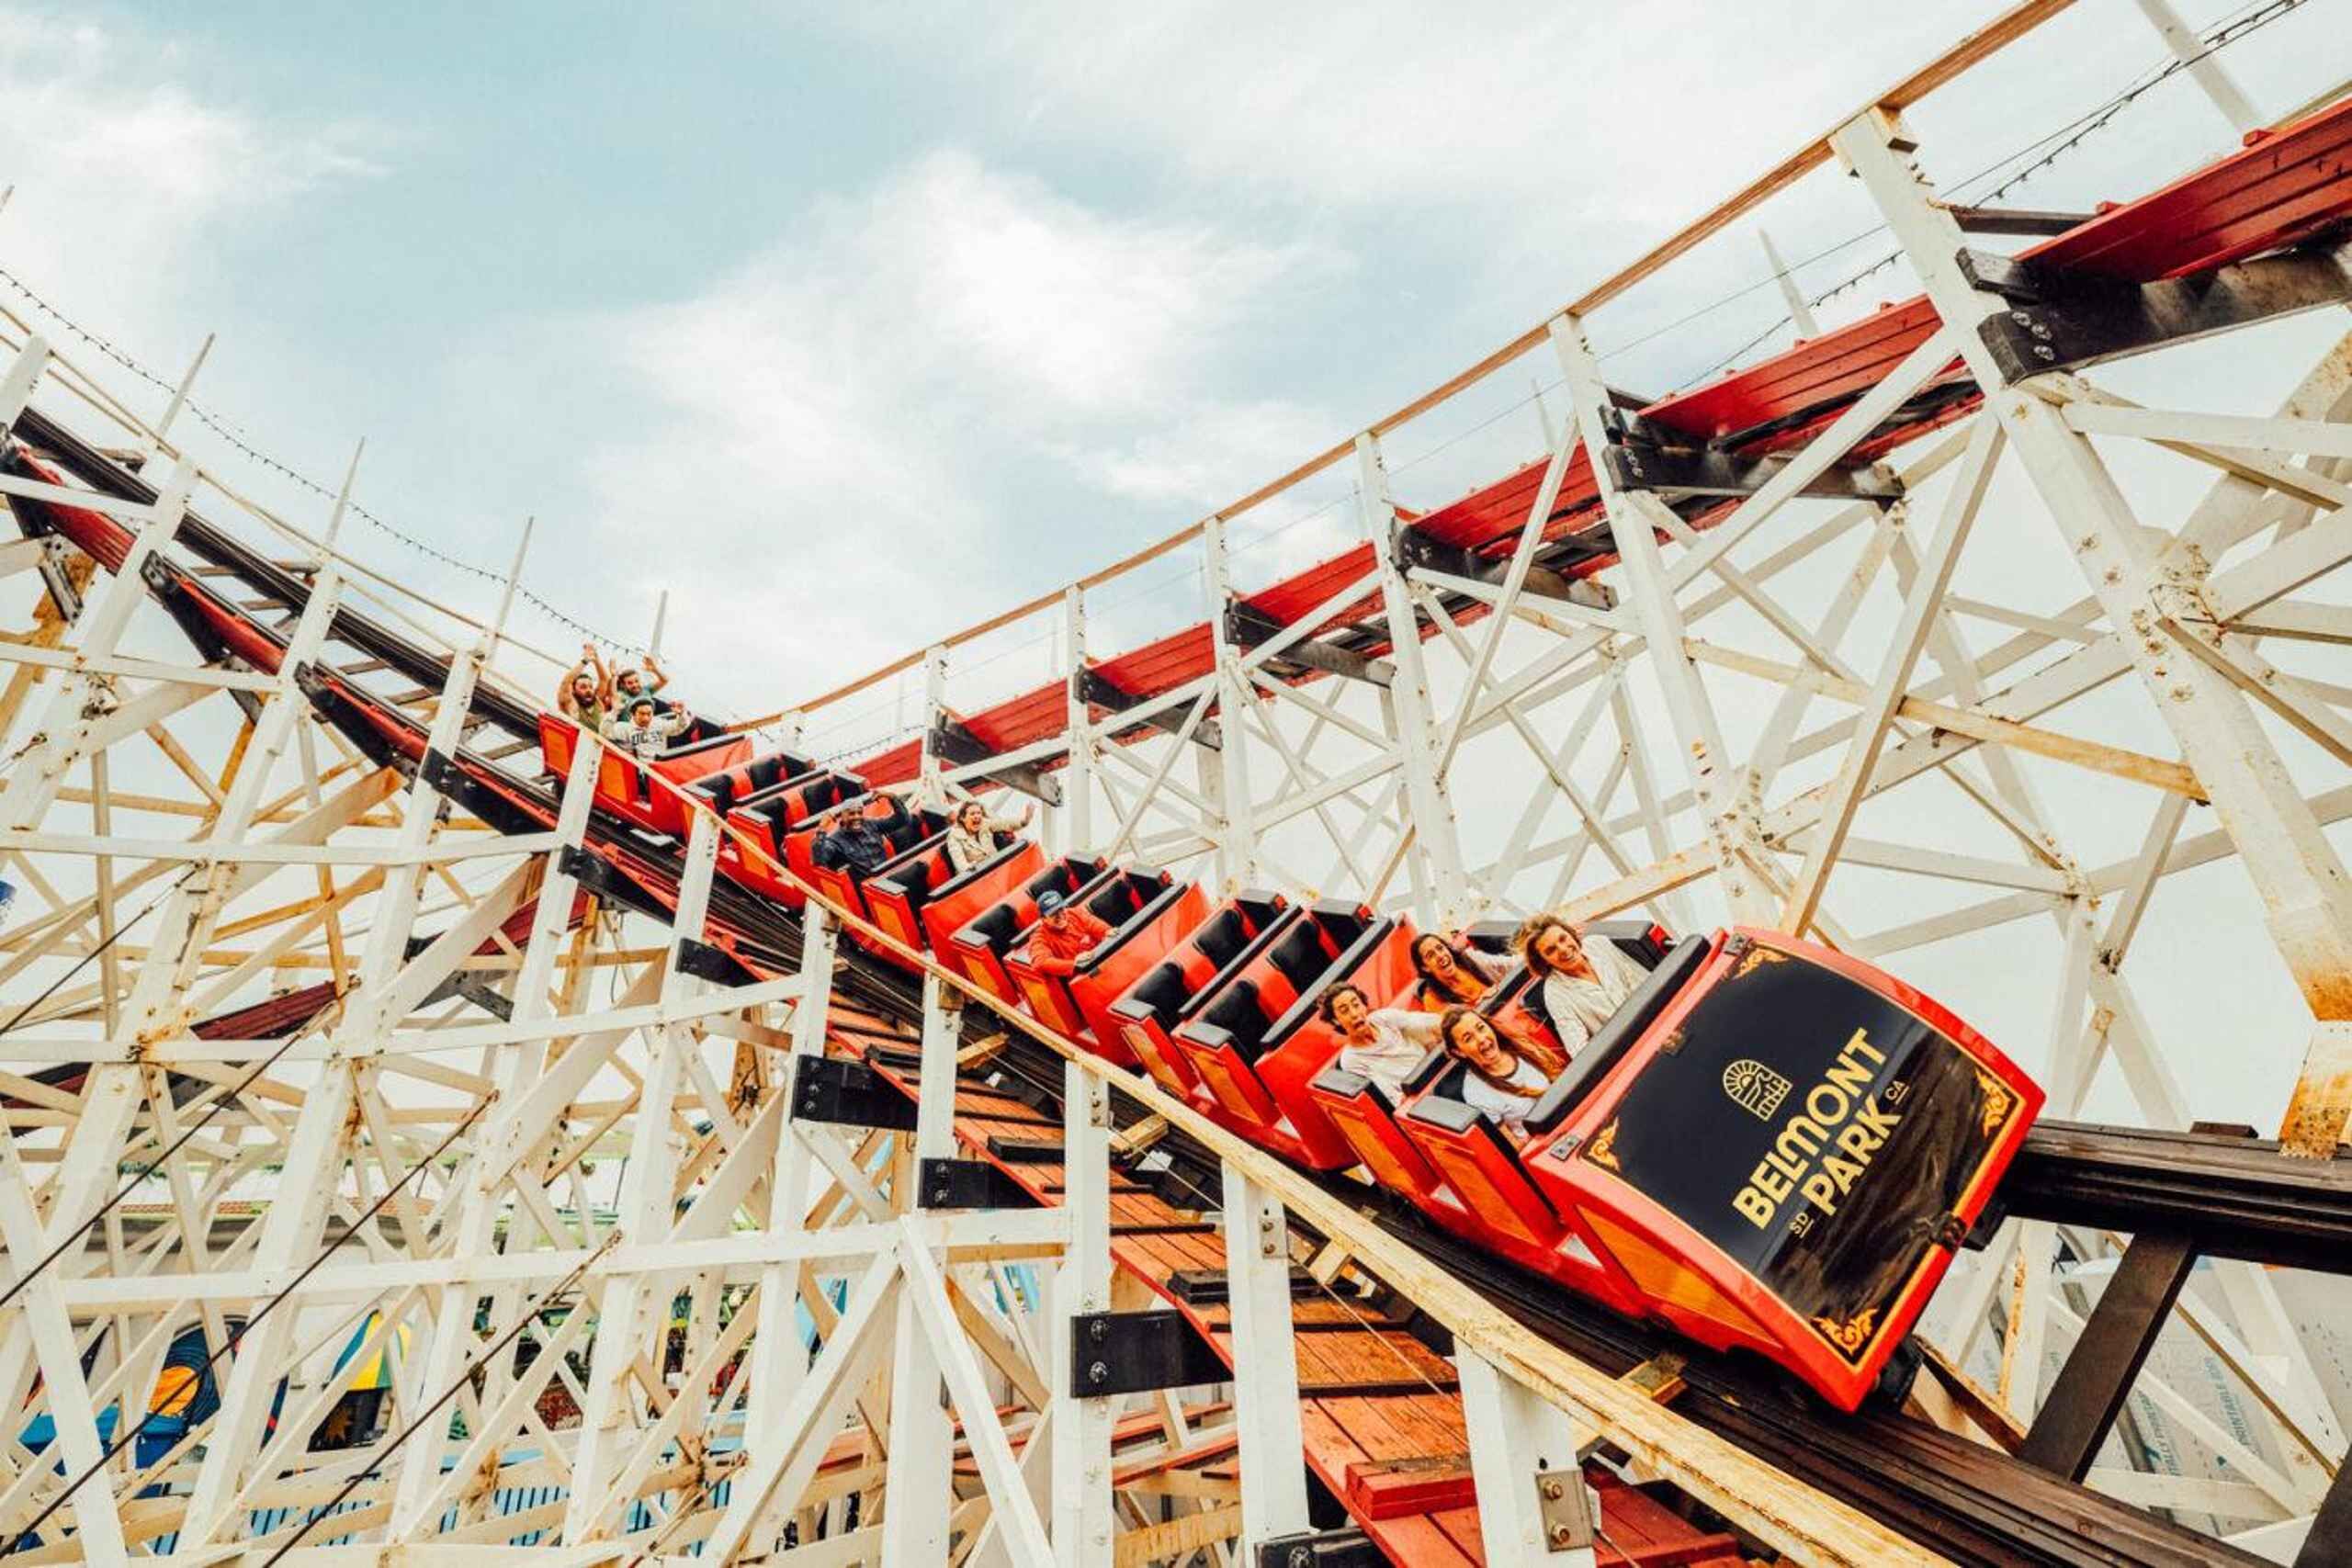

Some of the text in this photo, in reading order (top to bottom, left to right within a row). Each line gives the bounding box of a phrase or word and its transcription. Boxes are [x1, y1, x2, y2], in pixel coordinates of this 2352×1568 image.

[1732, 1027, 1888, 1230] BELMONT
[1789, 1079, 1908, 1237] SD PARK CA
